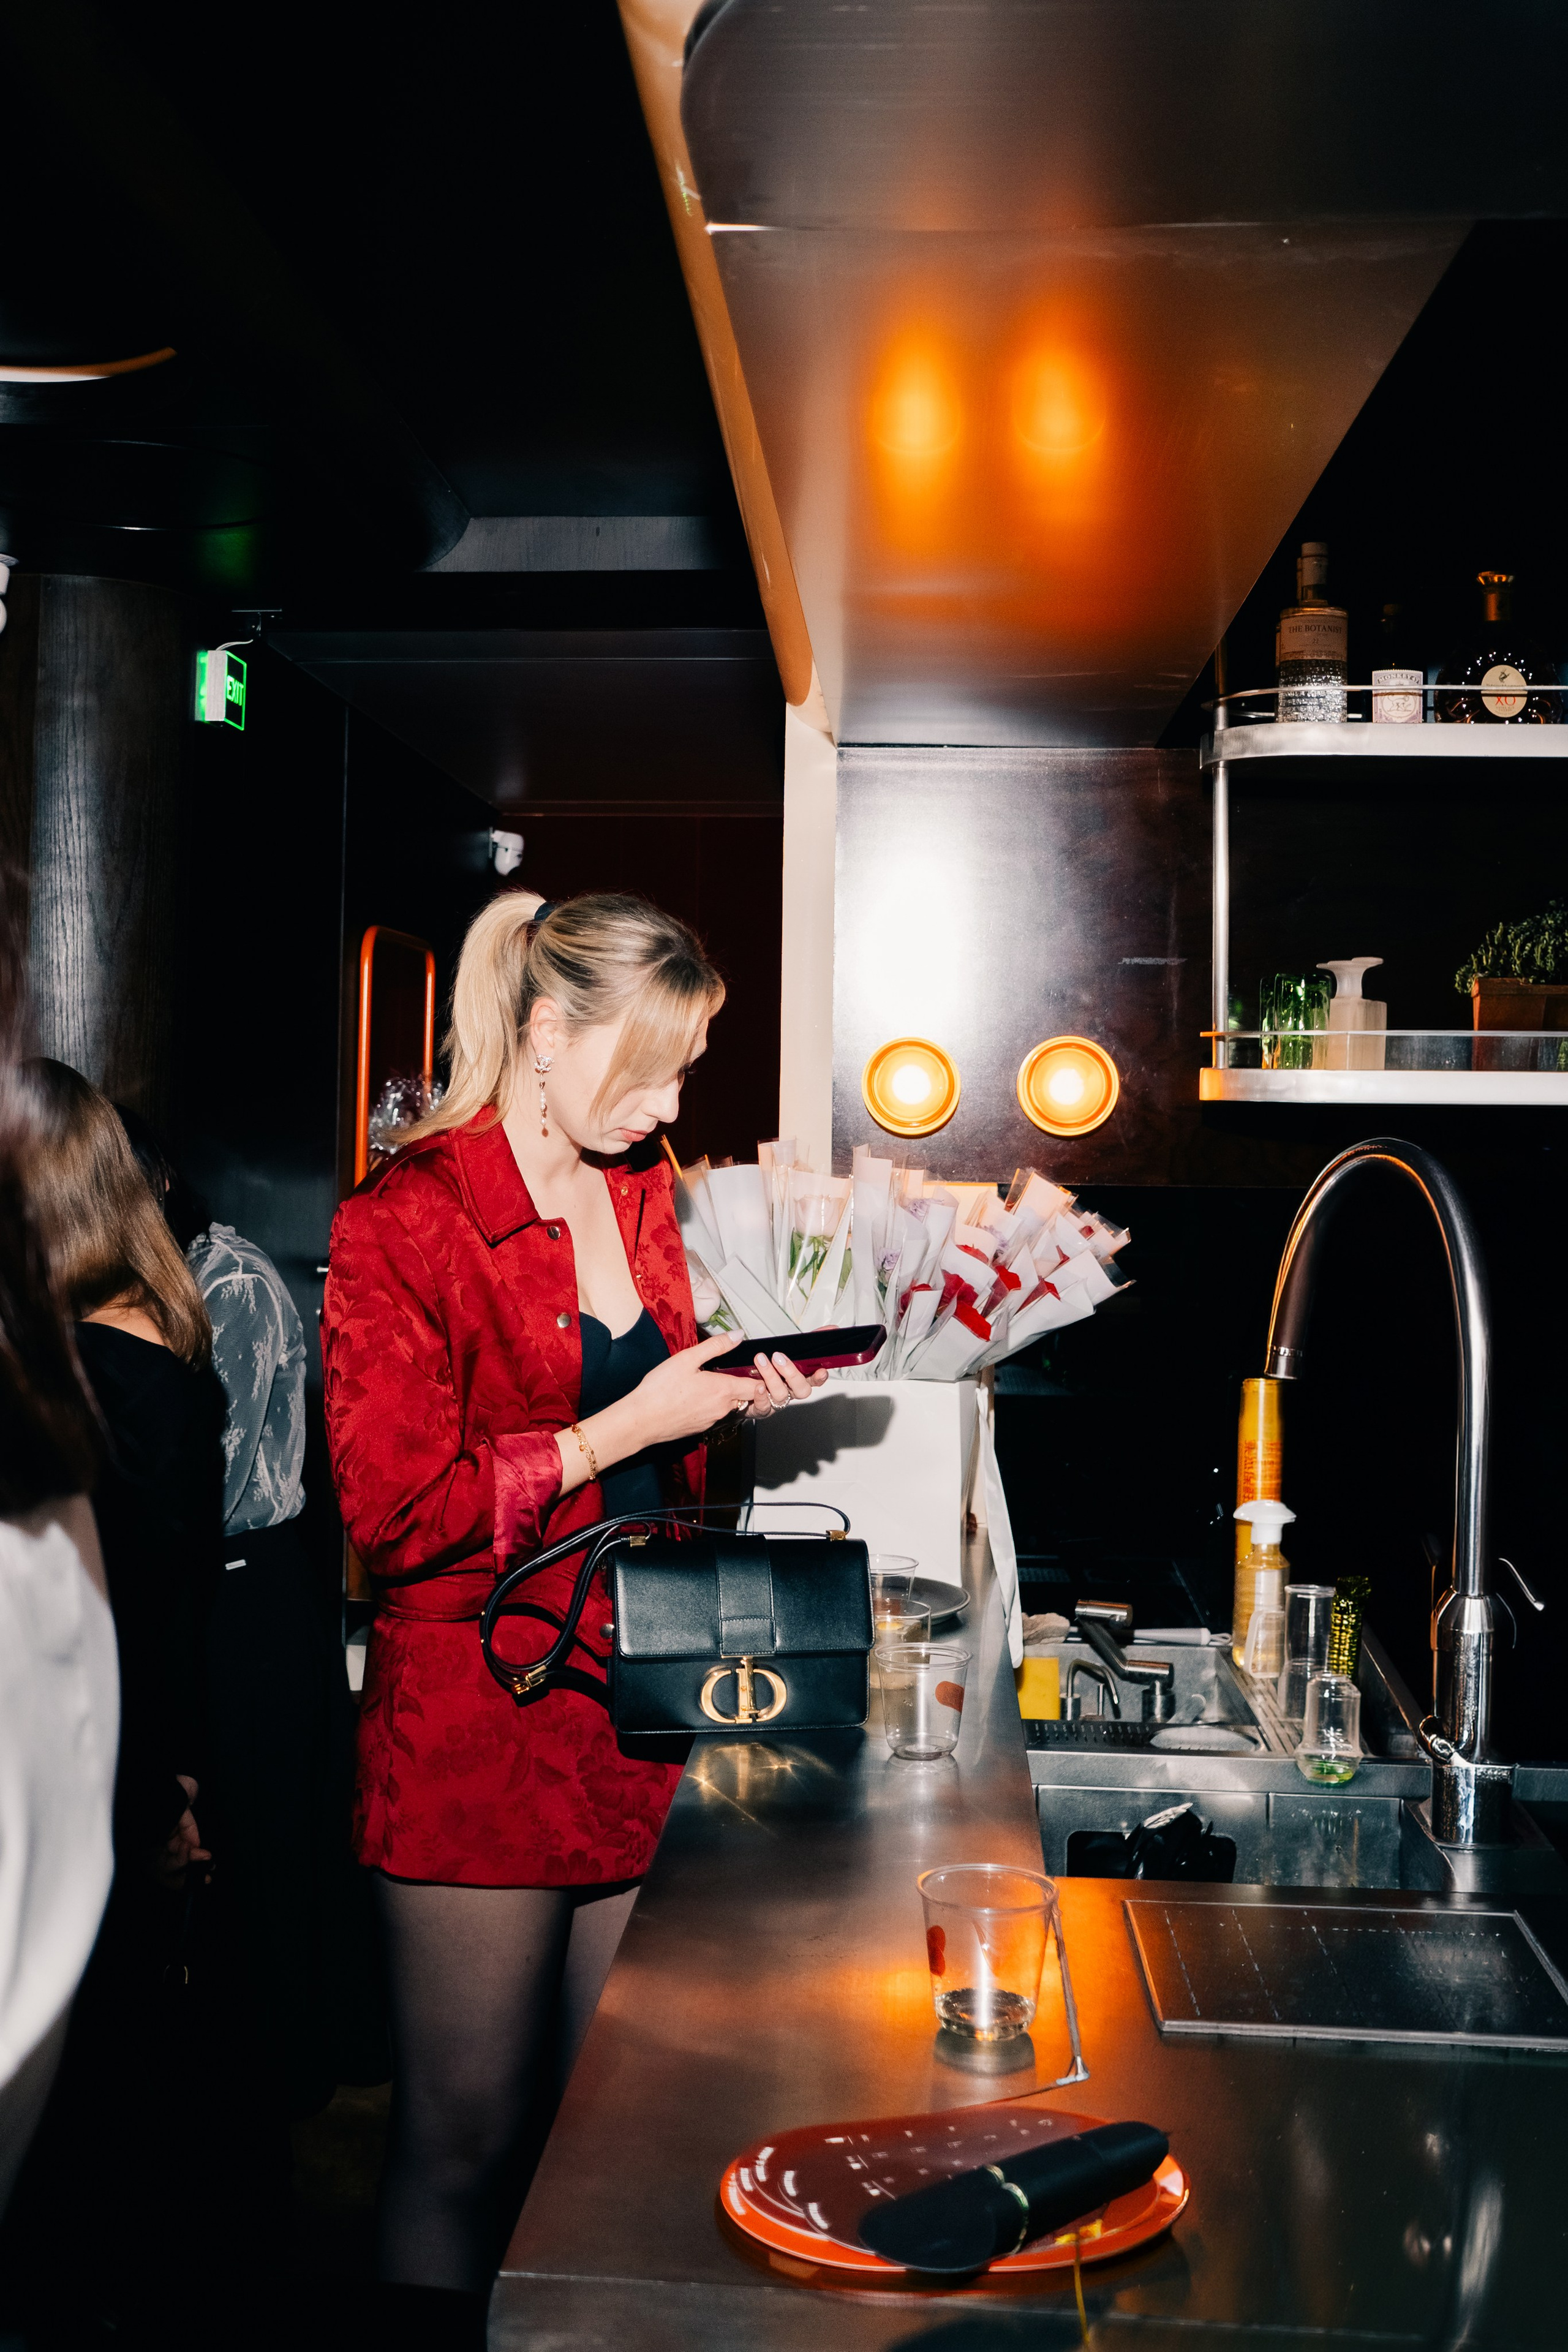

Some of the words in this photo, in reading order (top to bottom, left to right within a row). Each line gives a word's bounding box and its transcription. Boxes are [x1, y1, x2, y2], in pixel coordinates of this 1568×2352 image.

[1305, 625, 1342, 633] BOTANIST
[1378, 673, 1411, 684] MONKEY
[227, 675, 244, 706] EXIT
[1495, 696, 1517, 706] XO
